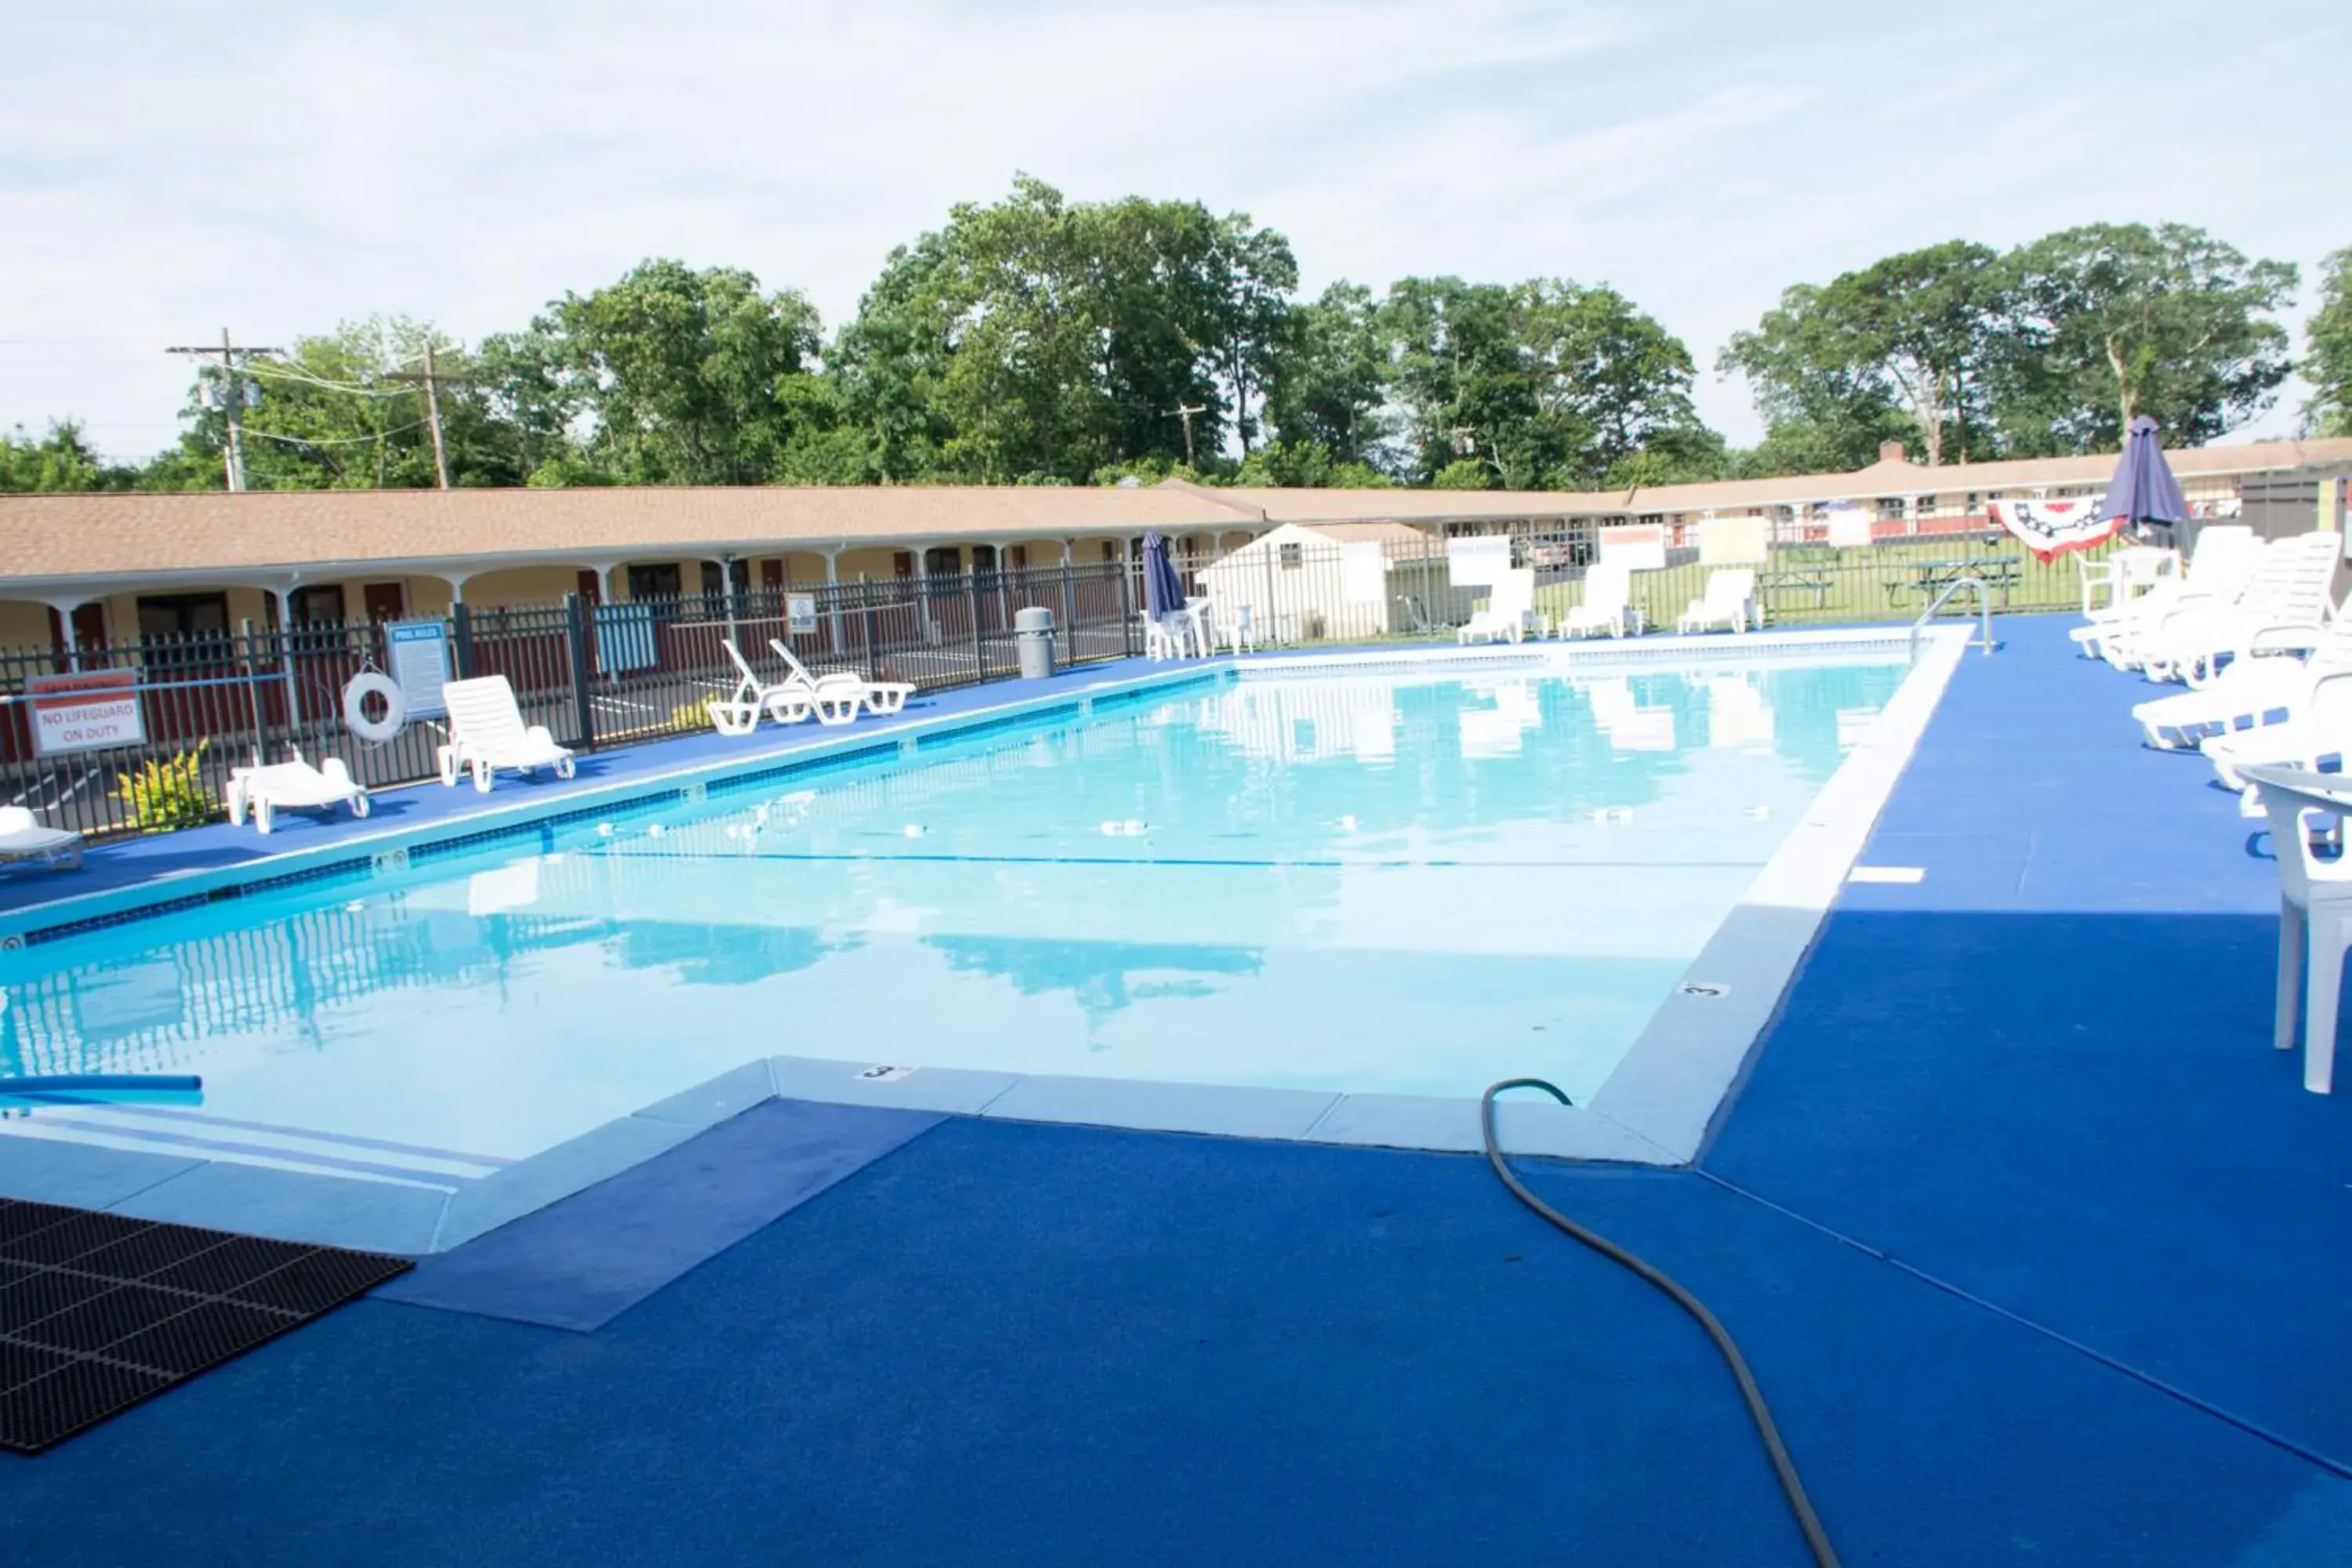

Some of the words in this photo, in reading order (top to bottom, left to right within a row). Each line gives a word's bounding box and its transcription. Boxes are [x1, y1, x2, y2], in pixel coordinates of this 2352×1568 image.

[42, 713, 62, 725] NO
[66, 705, 133, 724] LIFEGUARD
[64, 730, 82, 742] ON
[86, 725, 119, 739] DUTY
[863, 1066, 895, 1078] 3
